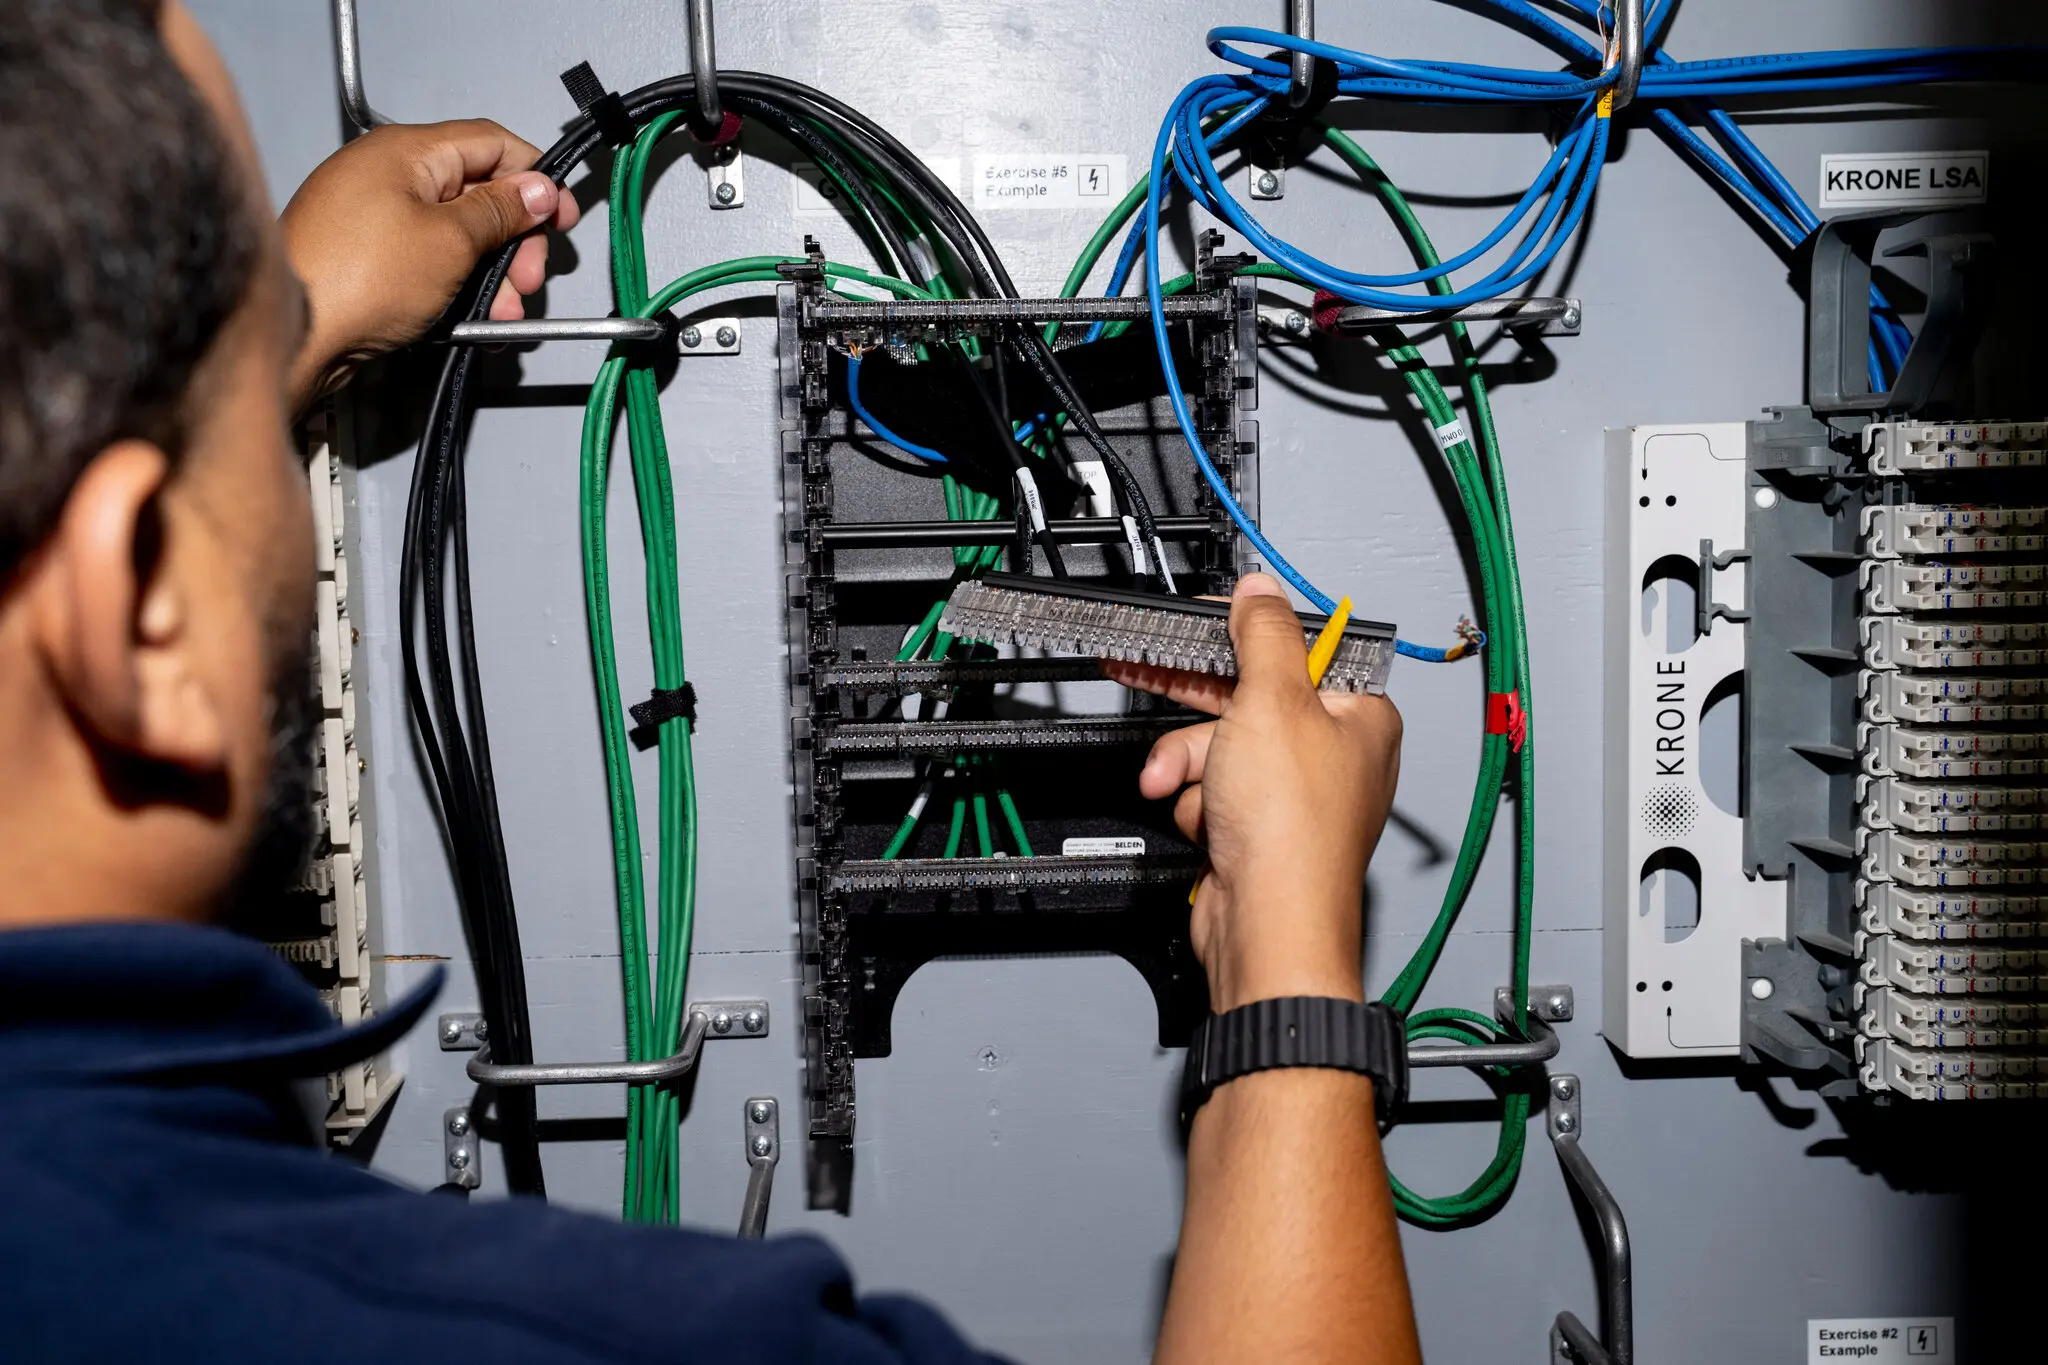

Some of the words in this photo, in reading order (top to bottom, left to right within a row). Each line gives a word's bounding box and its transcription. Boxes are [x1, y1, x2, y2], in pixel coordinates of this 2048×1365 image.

[985, 166, 1047, 179] Exercise
[1051, 165, 1068, 178] #5
[1828, 169, 1920, 190] KRONE
[1930, 167, 1981, 188] LSA
[985, 184, 1047, 198] Example
[1441, 428, 1465, 443] MW00
[1078, 471, 1097, 479] TOP
[1656, 661, 1685, 776] KRONE
[1115, 841, 1143, 849] BELDEN
[1819, 1328, 1878, 1340] Exercise
[1882, 1328, 1899, 1339] #2
[1819, 1345, 1878, 1358] Example
